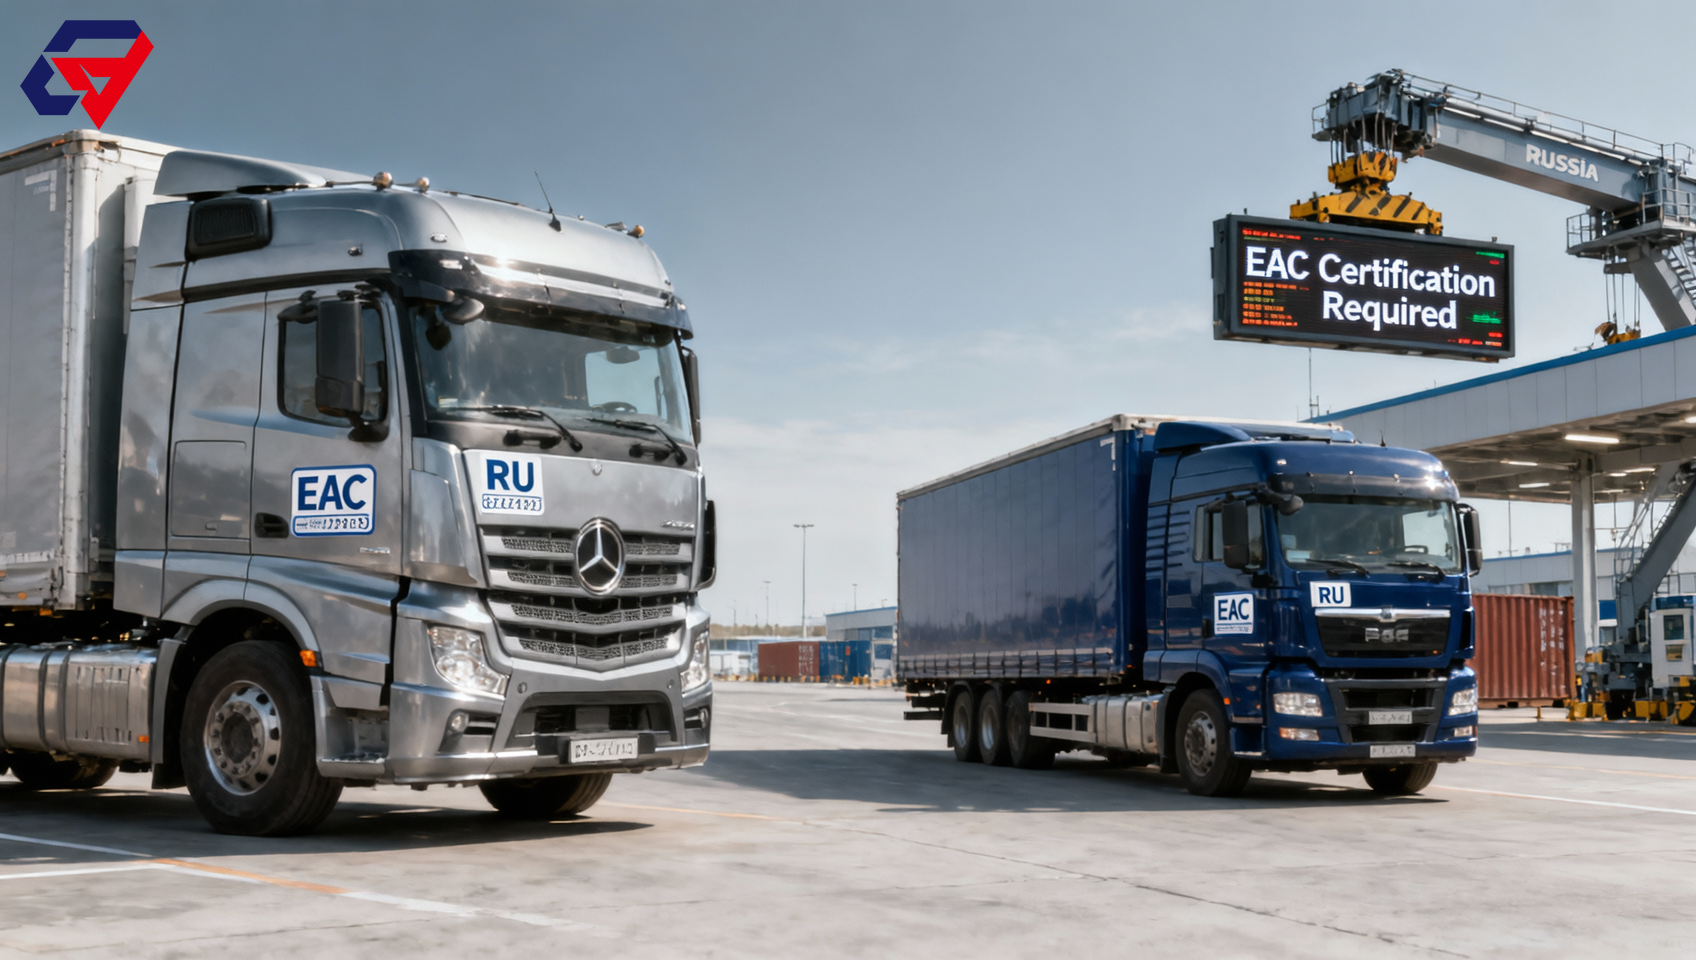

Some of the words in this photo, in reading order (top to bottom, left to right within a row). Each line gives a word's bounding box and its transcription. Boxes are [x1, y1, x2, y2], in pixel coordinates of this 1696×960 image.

[1526, 143, 1599, 182] RUSSIA
[1246, 246, 1310, 280] EAC
[1318, 253, 1496, 297] Certification
[1322, 290, 1458, 332] Required
[297, 474, 367, 511] EAC
[486, 459, 535, 492] RU
[1217, 598, 1250, 621] EAC
[1318, 586, 1345, 604] RU
